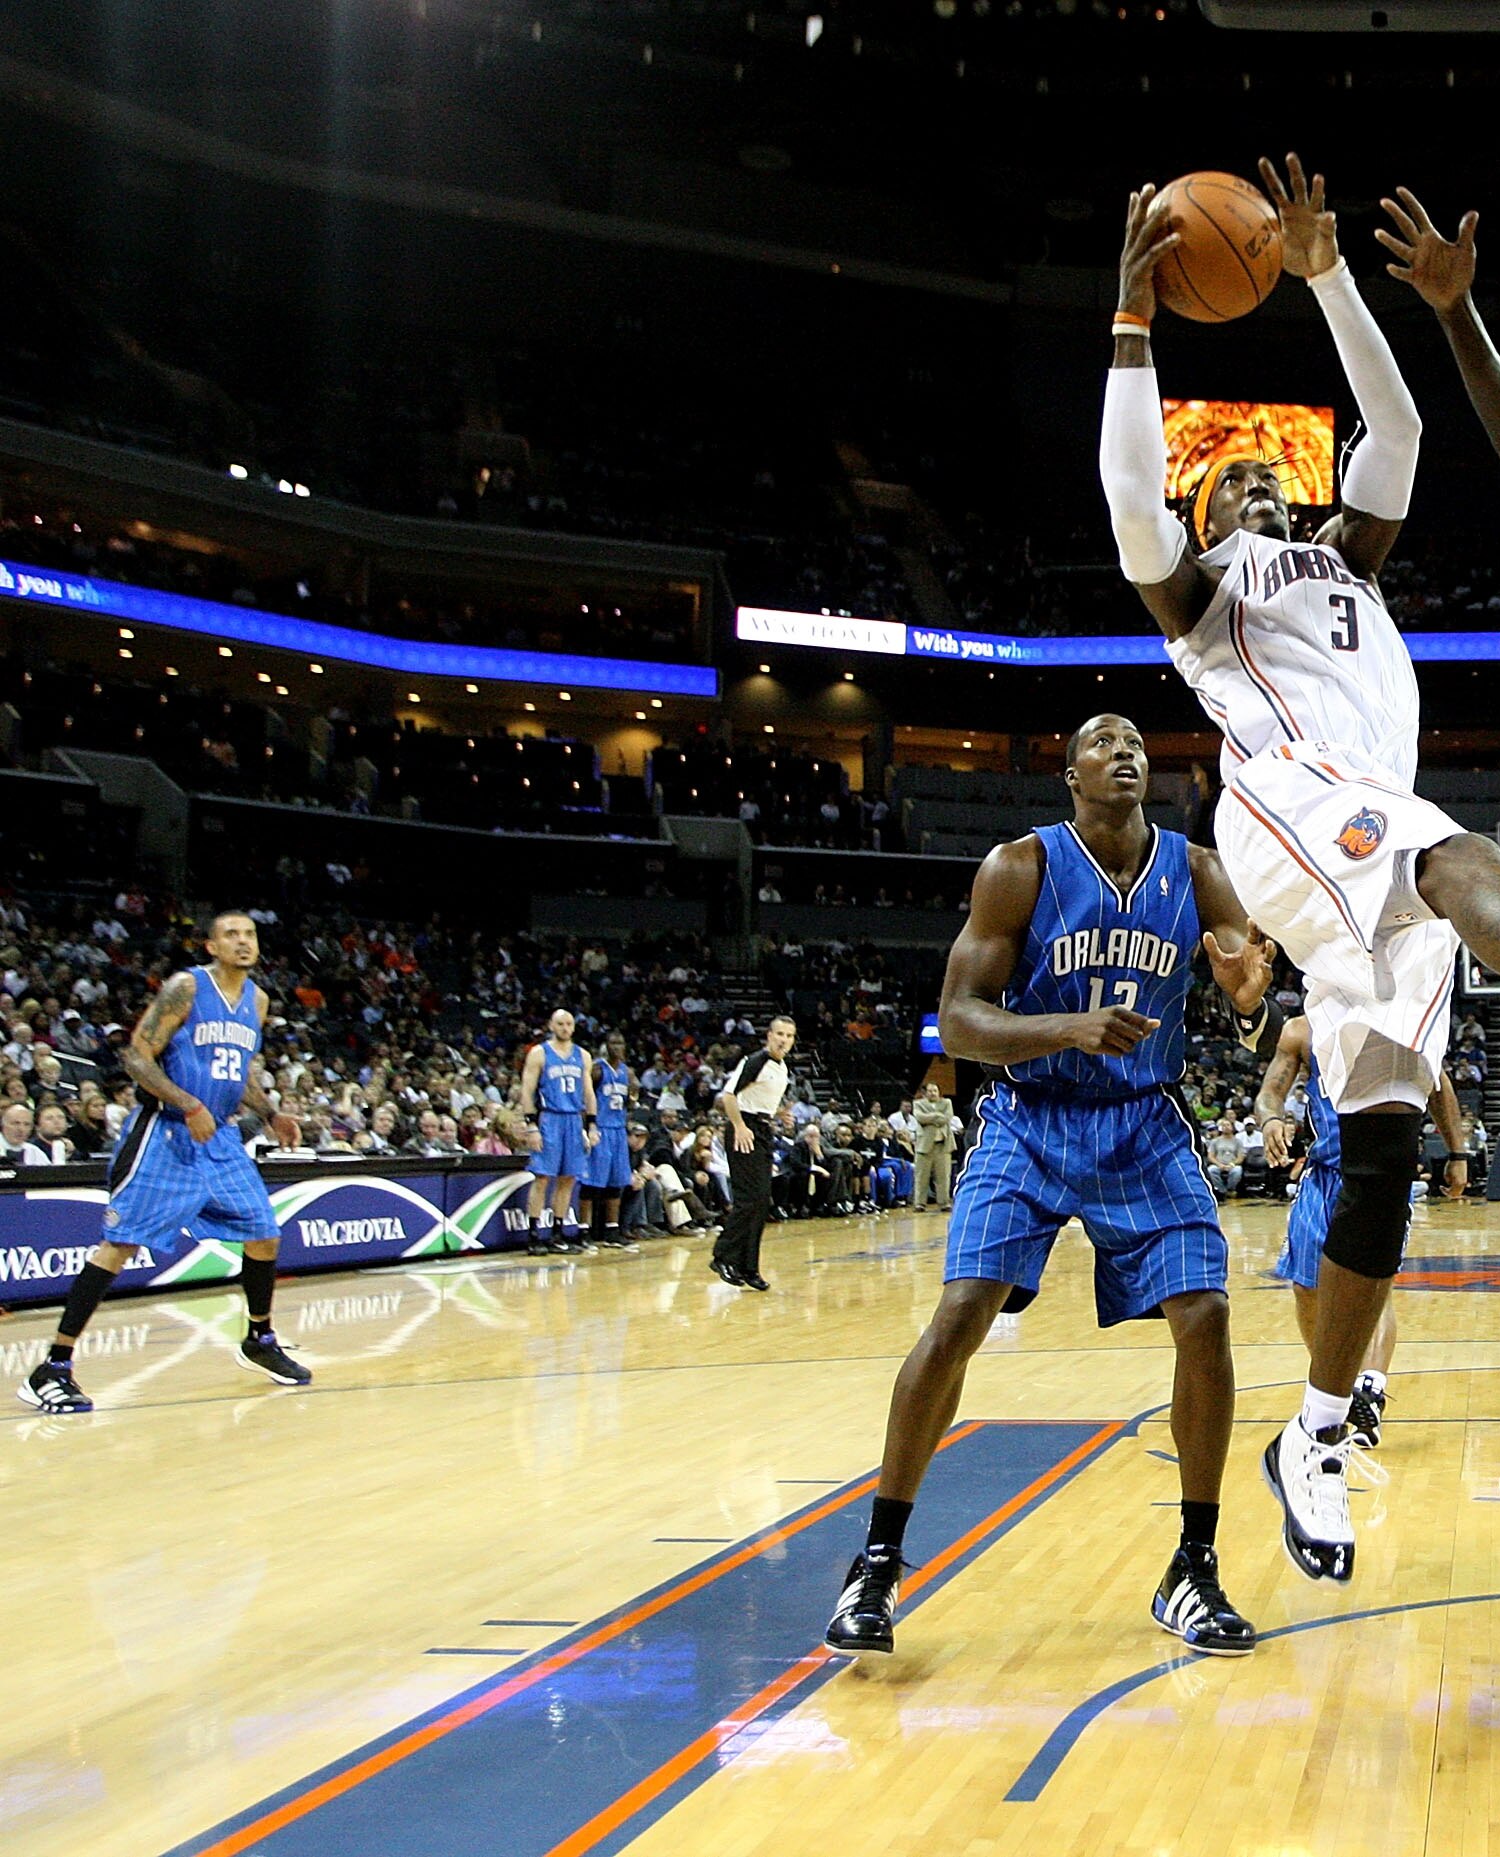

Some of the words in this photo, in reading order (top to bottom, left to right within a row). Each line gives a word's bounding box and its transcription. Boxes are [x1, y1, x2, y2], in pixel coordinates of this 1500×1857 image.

[17, 573, 62, 598] you
[1328, 593, 1359, 652] 3
[913, 631, 959, 654] With
[961, 640, 993, 659] you
[1053, 927, 1179, 978] ORLANDO
[194, 1020, 257, 1053] ORLANDO
[210, 1046, 242, 1082] 22
[560, 1076, 576, 1094] 13
[297, 1216, 407, 1248] WACHOVIA
